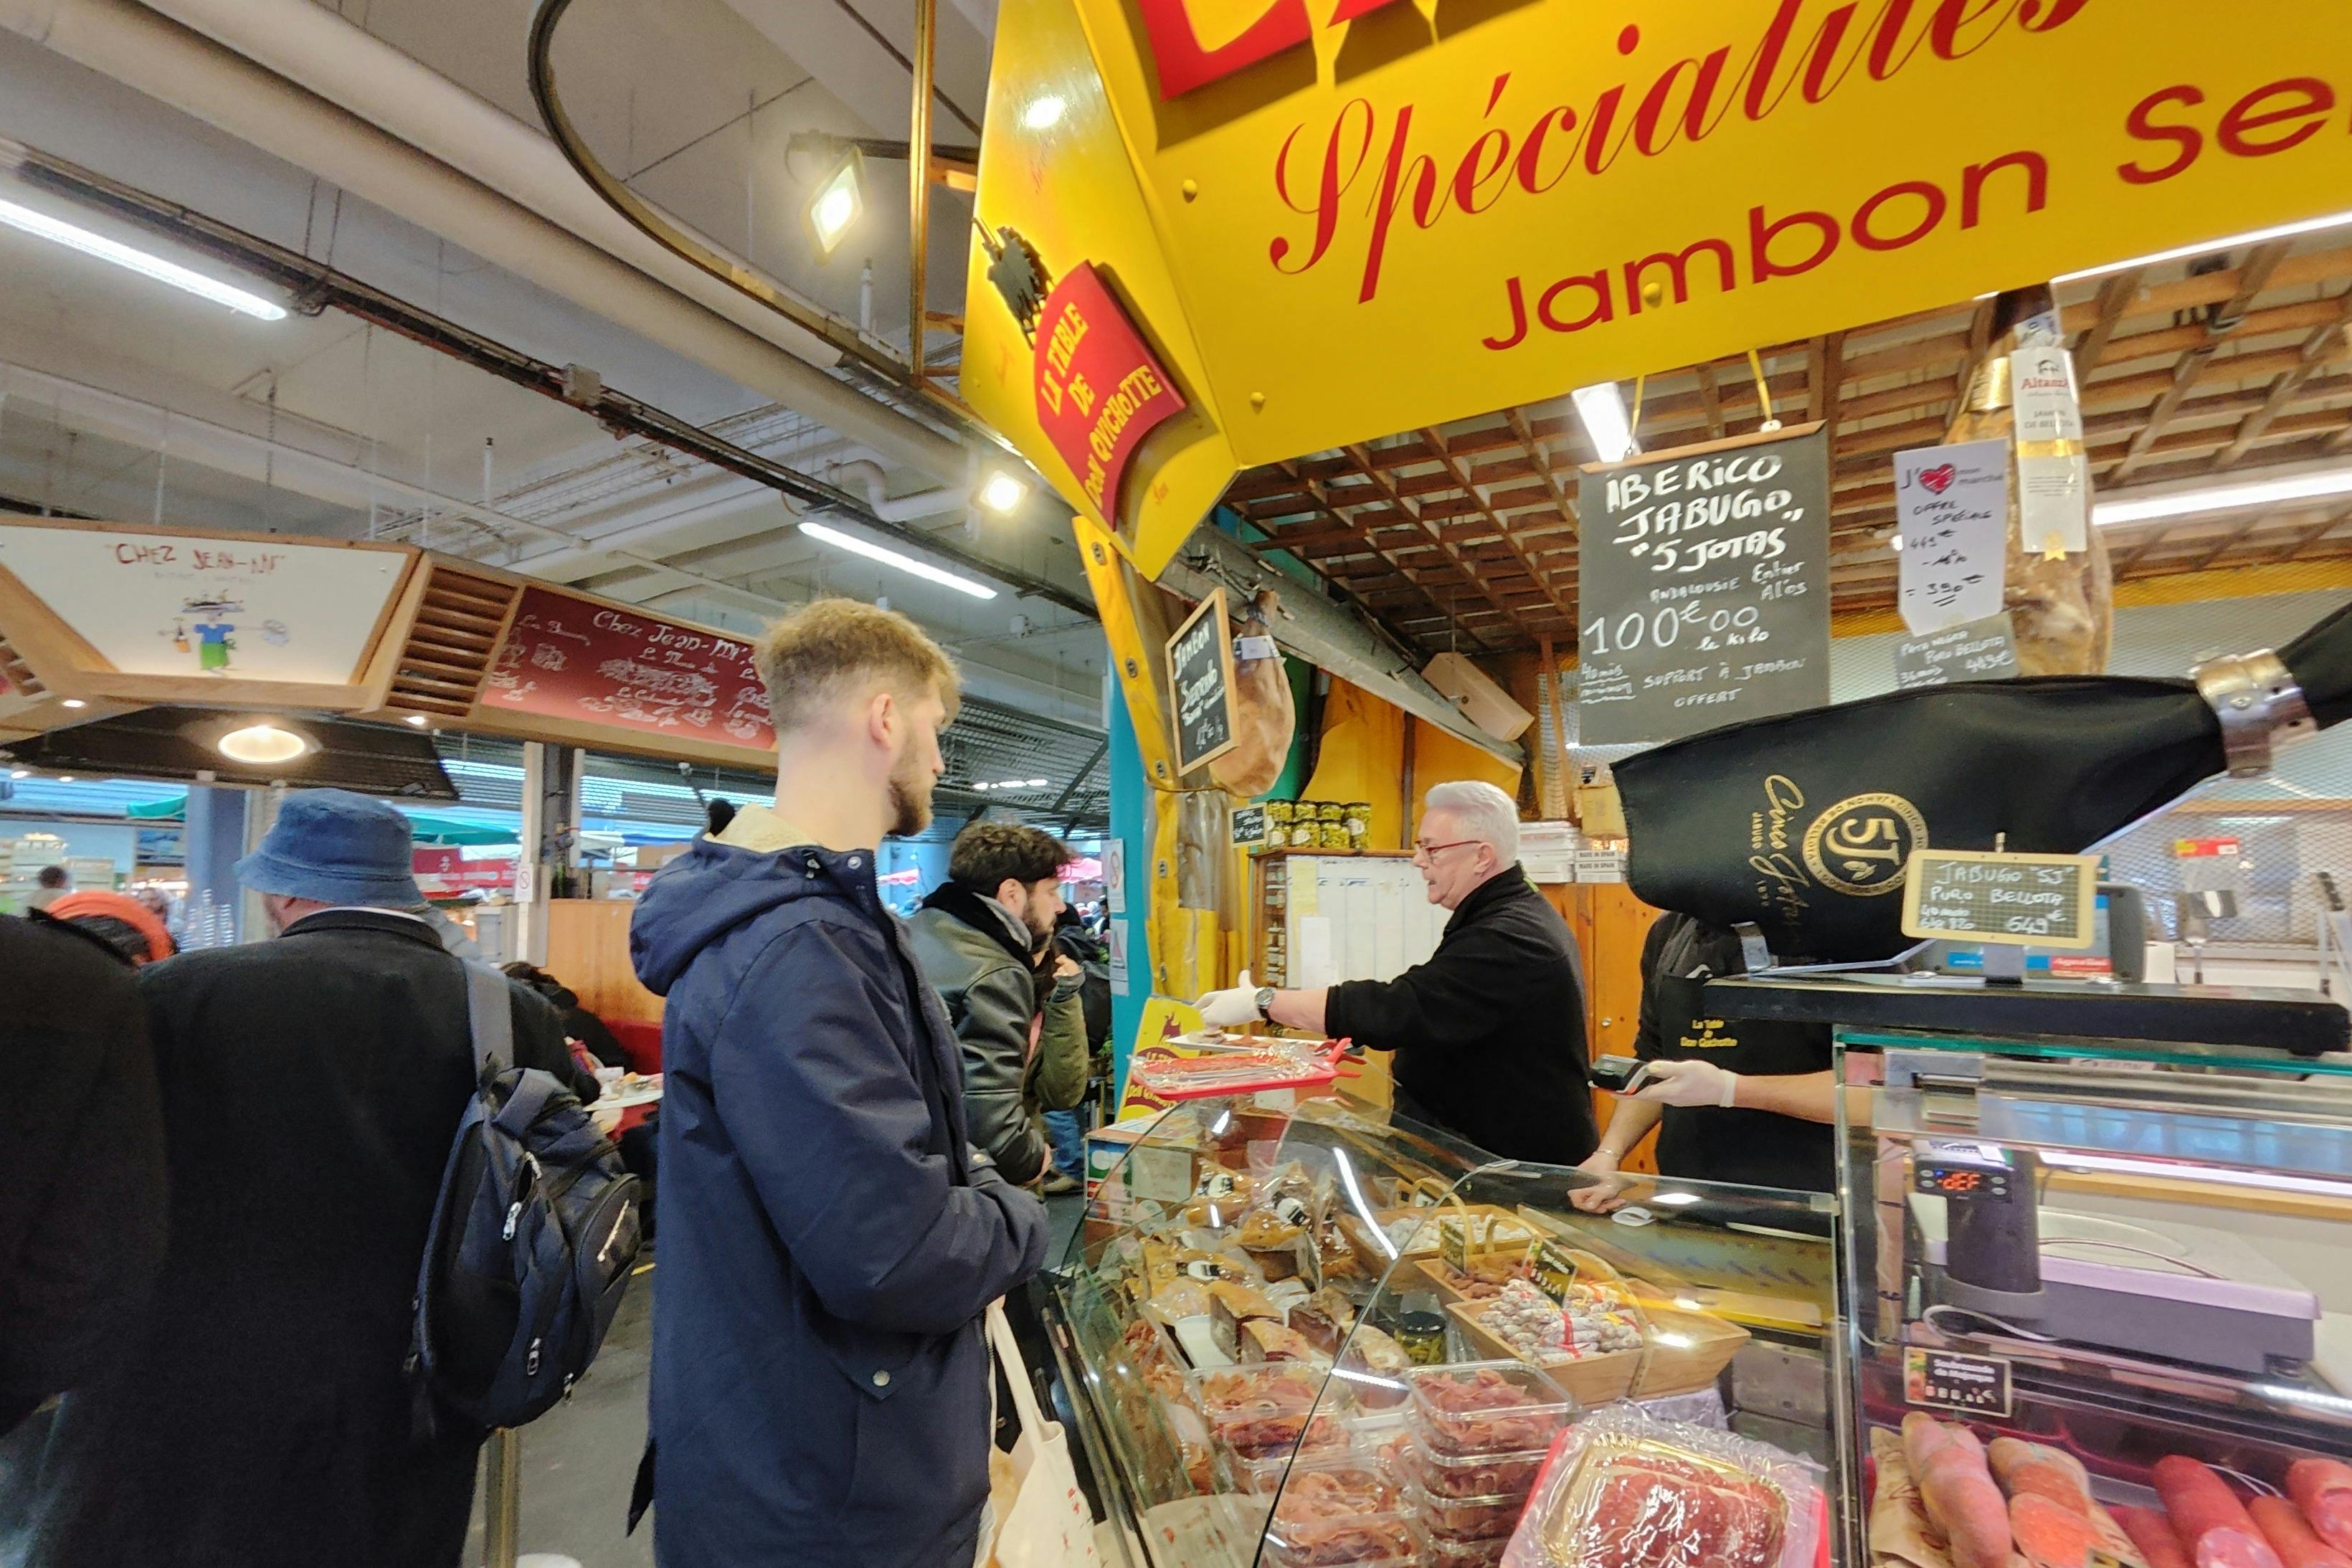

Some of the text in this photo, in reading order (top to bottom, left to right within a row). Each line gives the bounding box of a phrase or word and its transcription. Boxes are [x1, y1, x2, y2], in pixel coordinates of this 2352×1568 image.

[1481, 77, 2352, 351] Jambon Se
[1068, 371, 1096, 418] DE
[1764, 774, 1805, 850] Cinco
[1825, 817, 1900, 866] 5J
[1934, 861, 2023, 885] JABUGO
